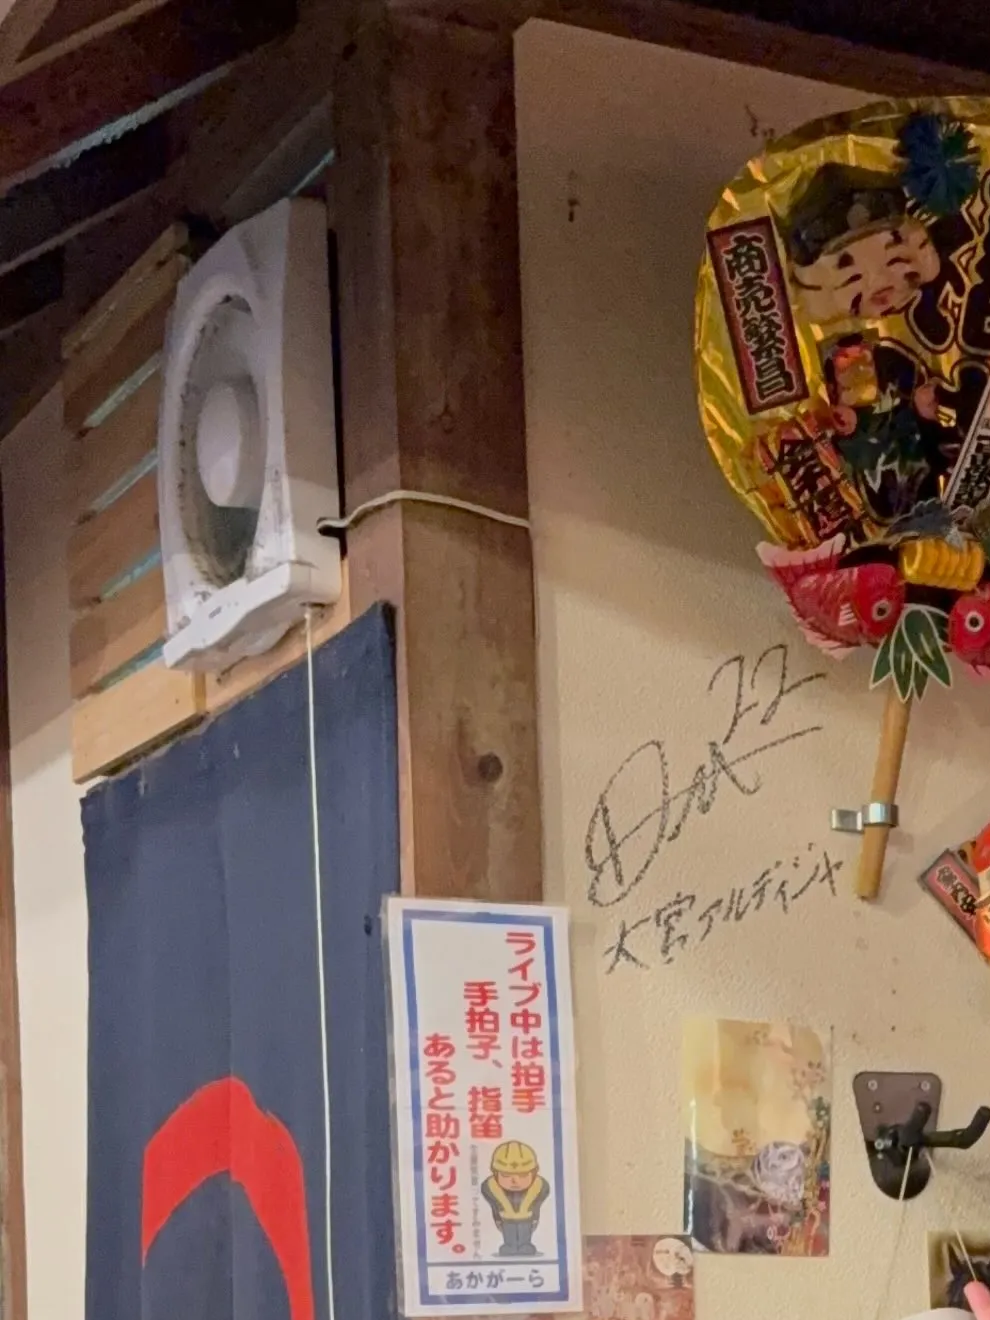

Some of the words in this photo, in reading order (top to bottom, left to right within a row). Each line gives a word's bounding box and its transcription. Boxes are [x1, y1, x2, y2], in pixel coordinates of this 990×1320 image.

[505, 931, 546, 1113] ライブ中は拍手
[423, 1034, 467, 1254] あると助かります。
[467, 1086, 504, 1140] 指笛
[445, 1269, 545, 1290] あかがーら
